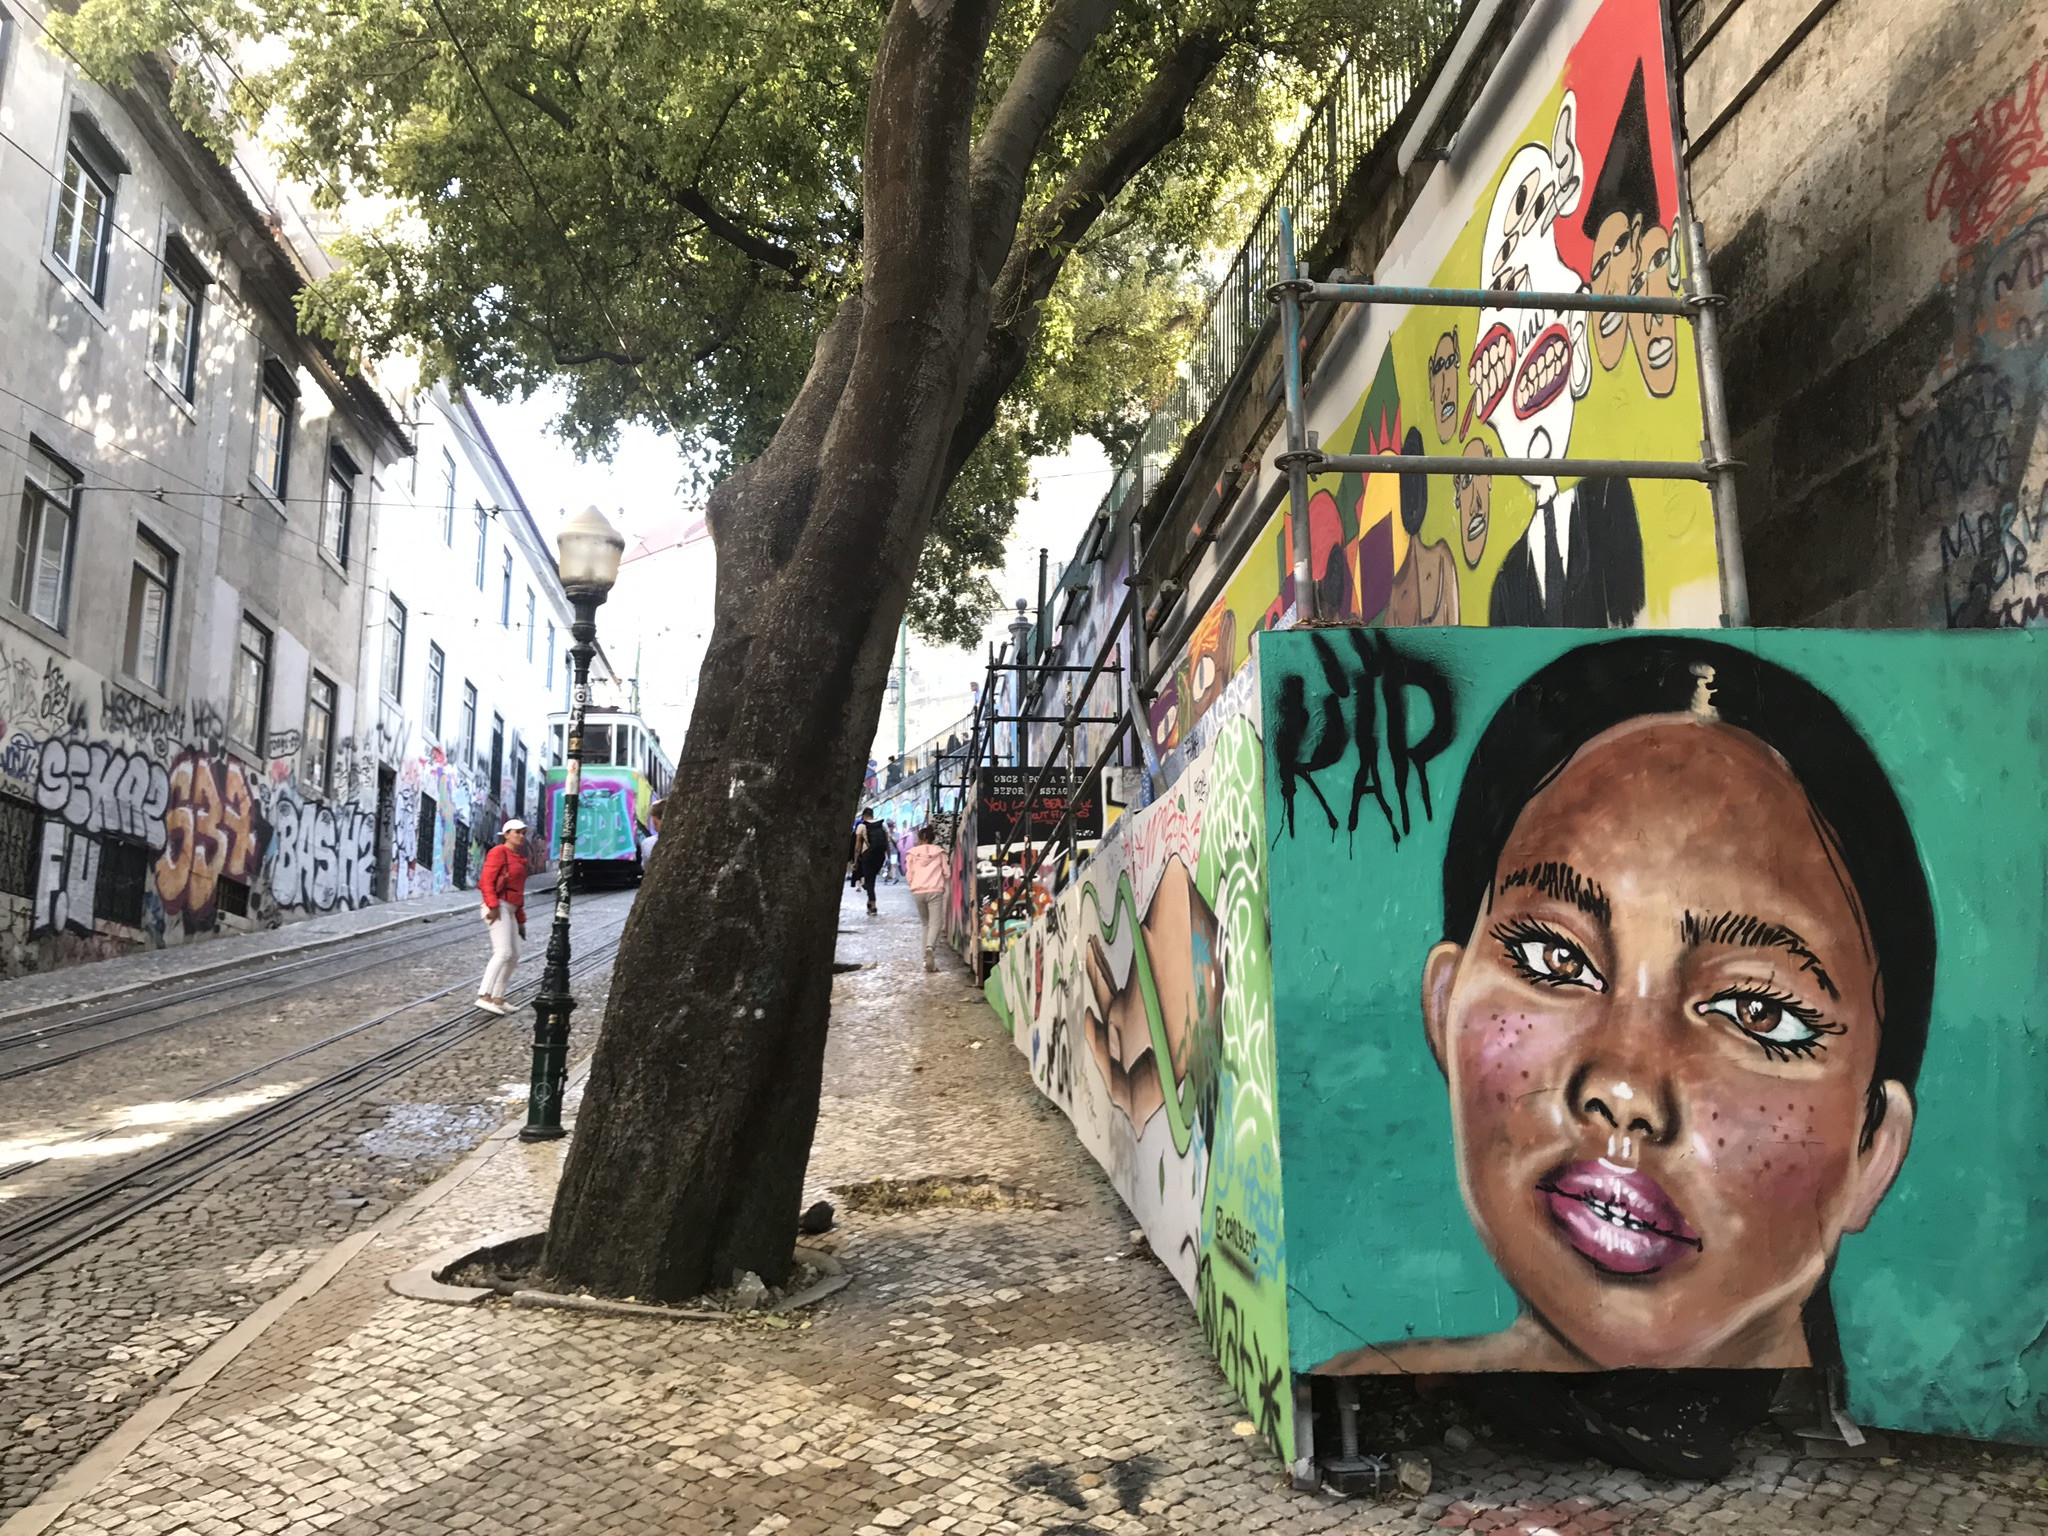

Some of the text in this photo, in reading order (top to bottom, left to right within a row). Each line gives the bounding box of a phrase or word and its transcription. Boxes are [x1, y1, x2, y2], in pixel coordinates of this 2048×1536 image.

[993, 775, 1018, 784] ONCE
[1050, 775, 1057, 784] A
[993, 787, 1028, 795] BEFOR
[984, 797, 1007, 812] YOU
